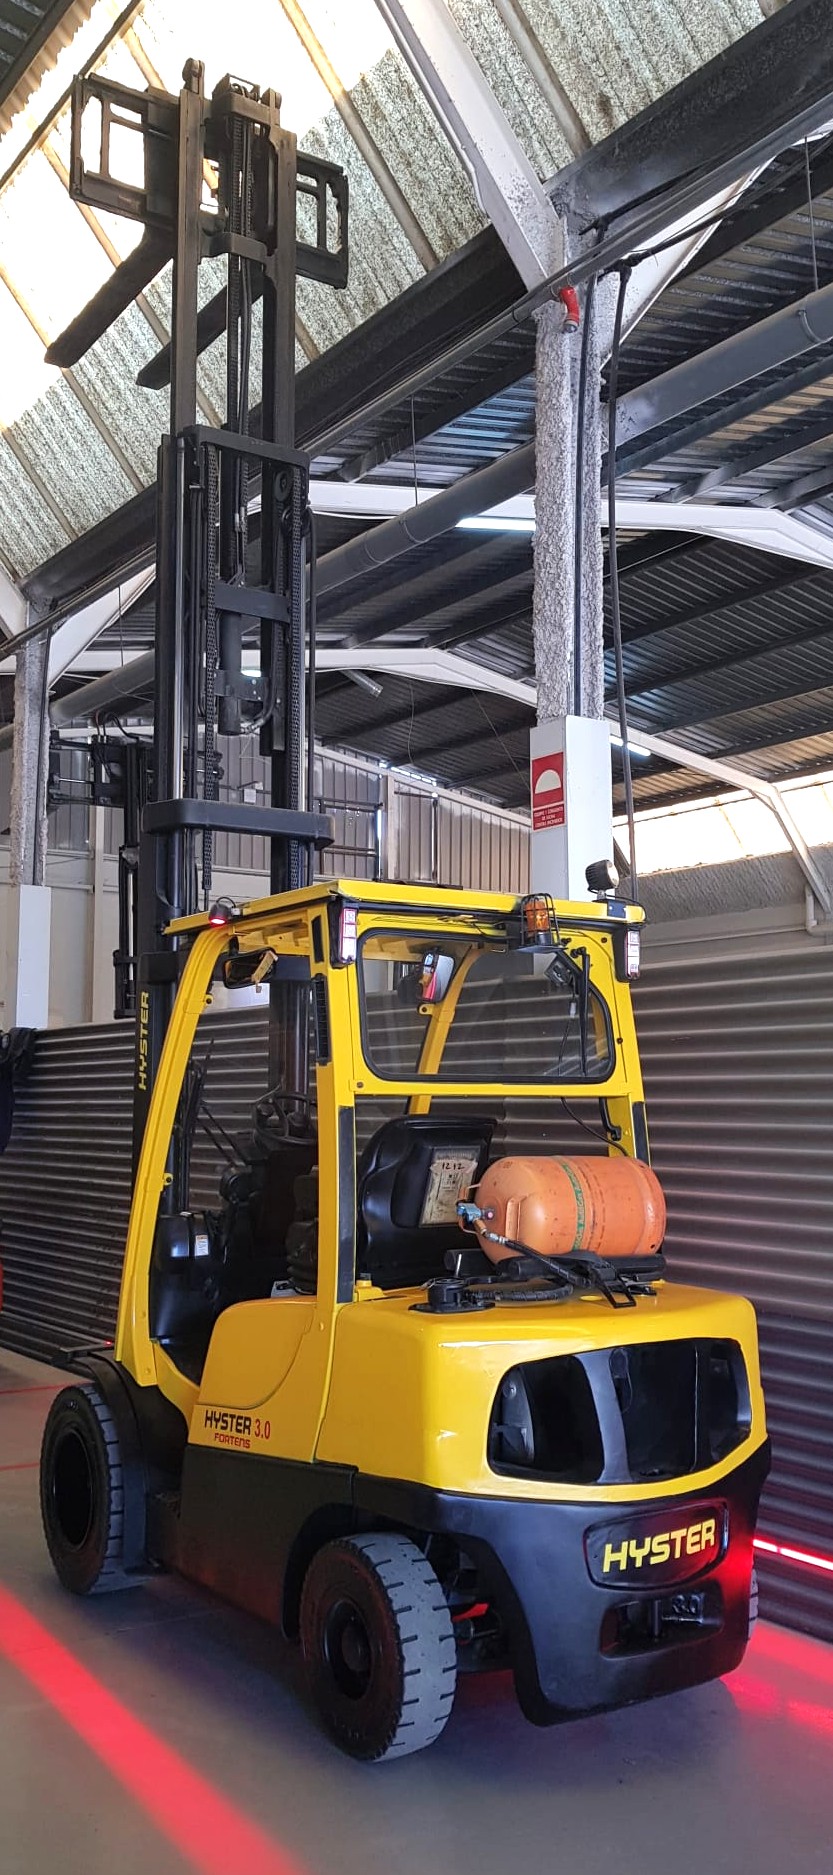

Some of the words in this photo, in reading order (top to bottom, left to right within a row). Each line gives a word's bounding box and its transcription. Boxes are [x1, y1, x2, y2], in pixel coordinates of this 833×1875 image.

[138, 991, 149, 1090] HYSTER
[204, 1409, 252, 1435] HYSTER
[254, 1418, 271, 1440] 3.0
[214, 1432, 251, 1449] FORTENS
[602, 1518, 716, 1573] HYSTER
